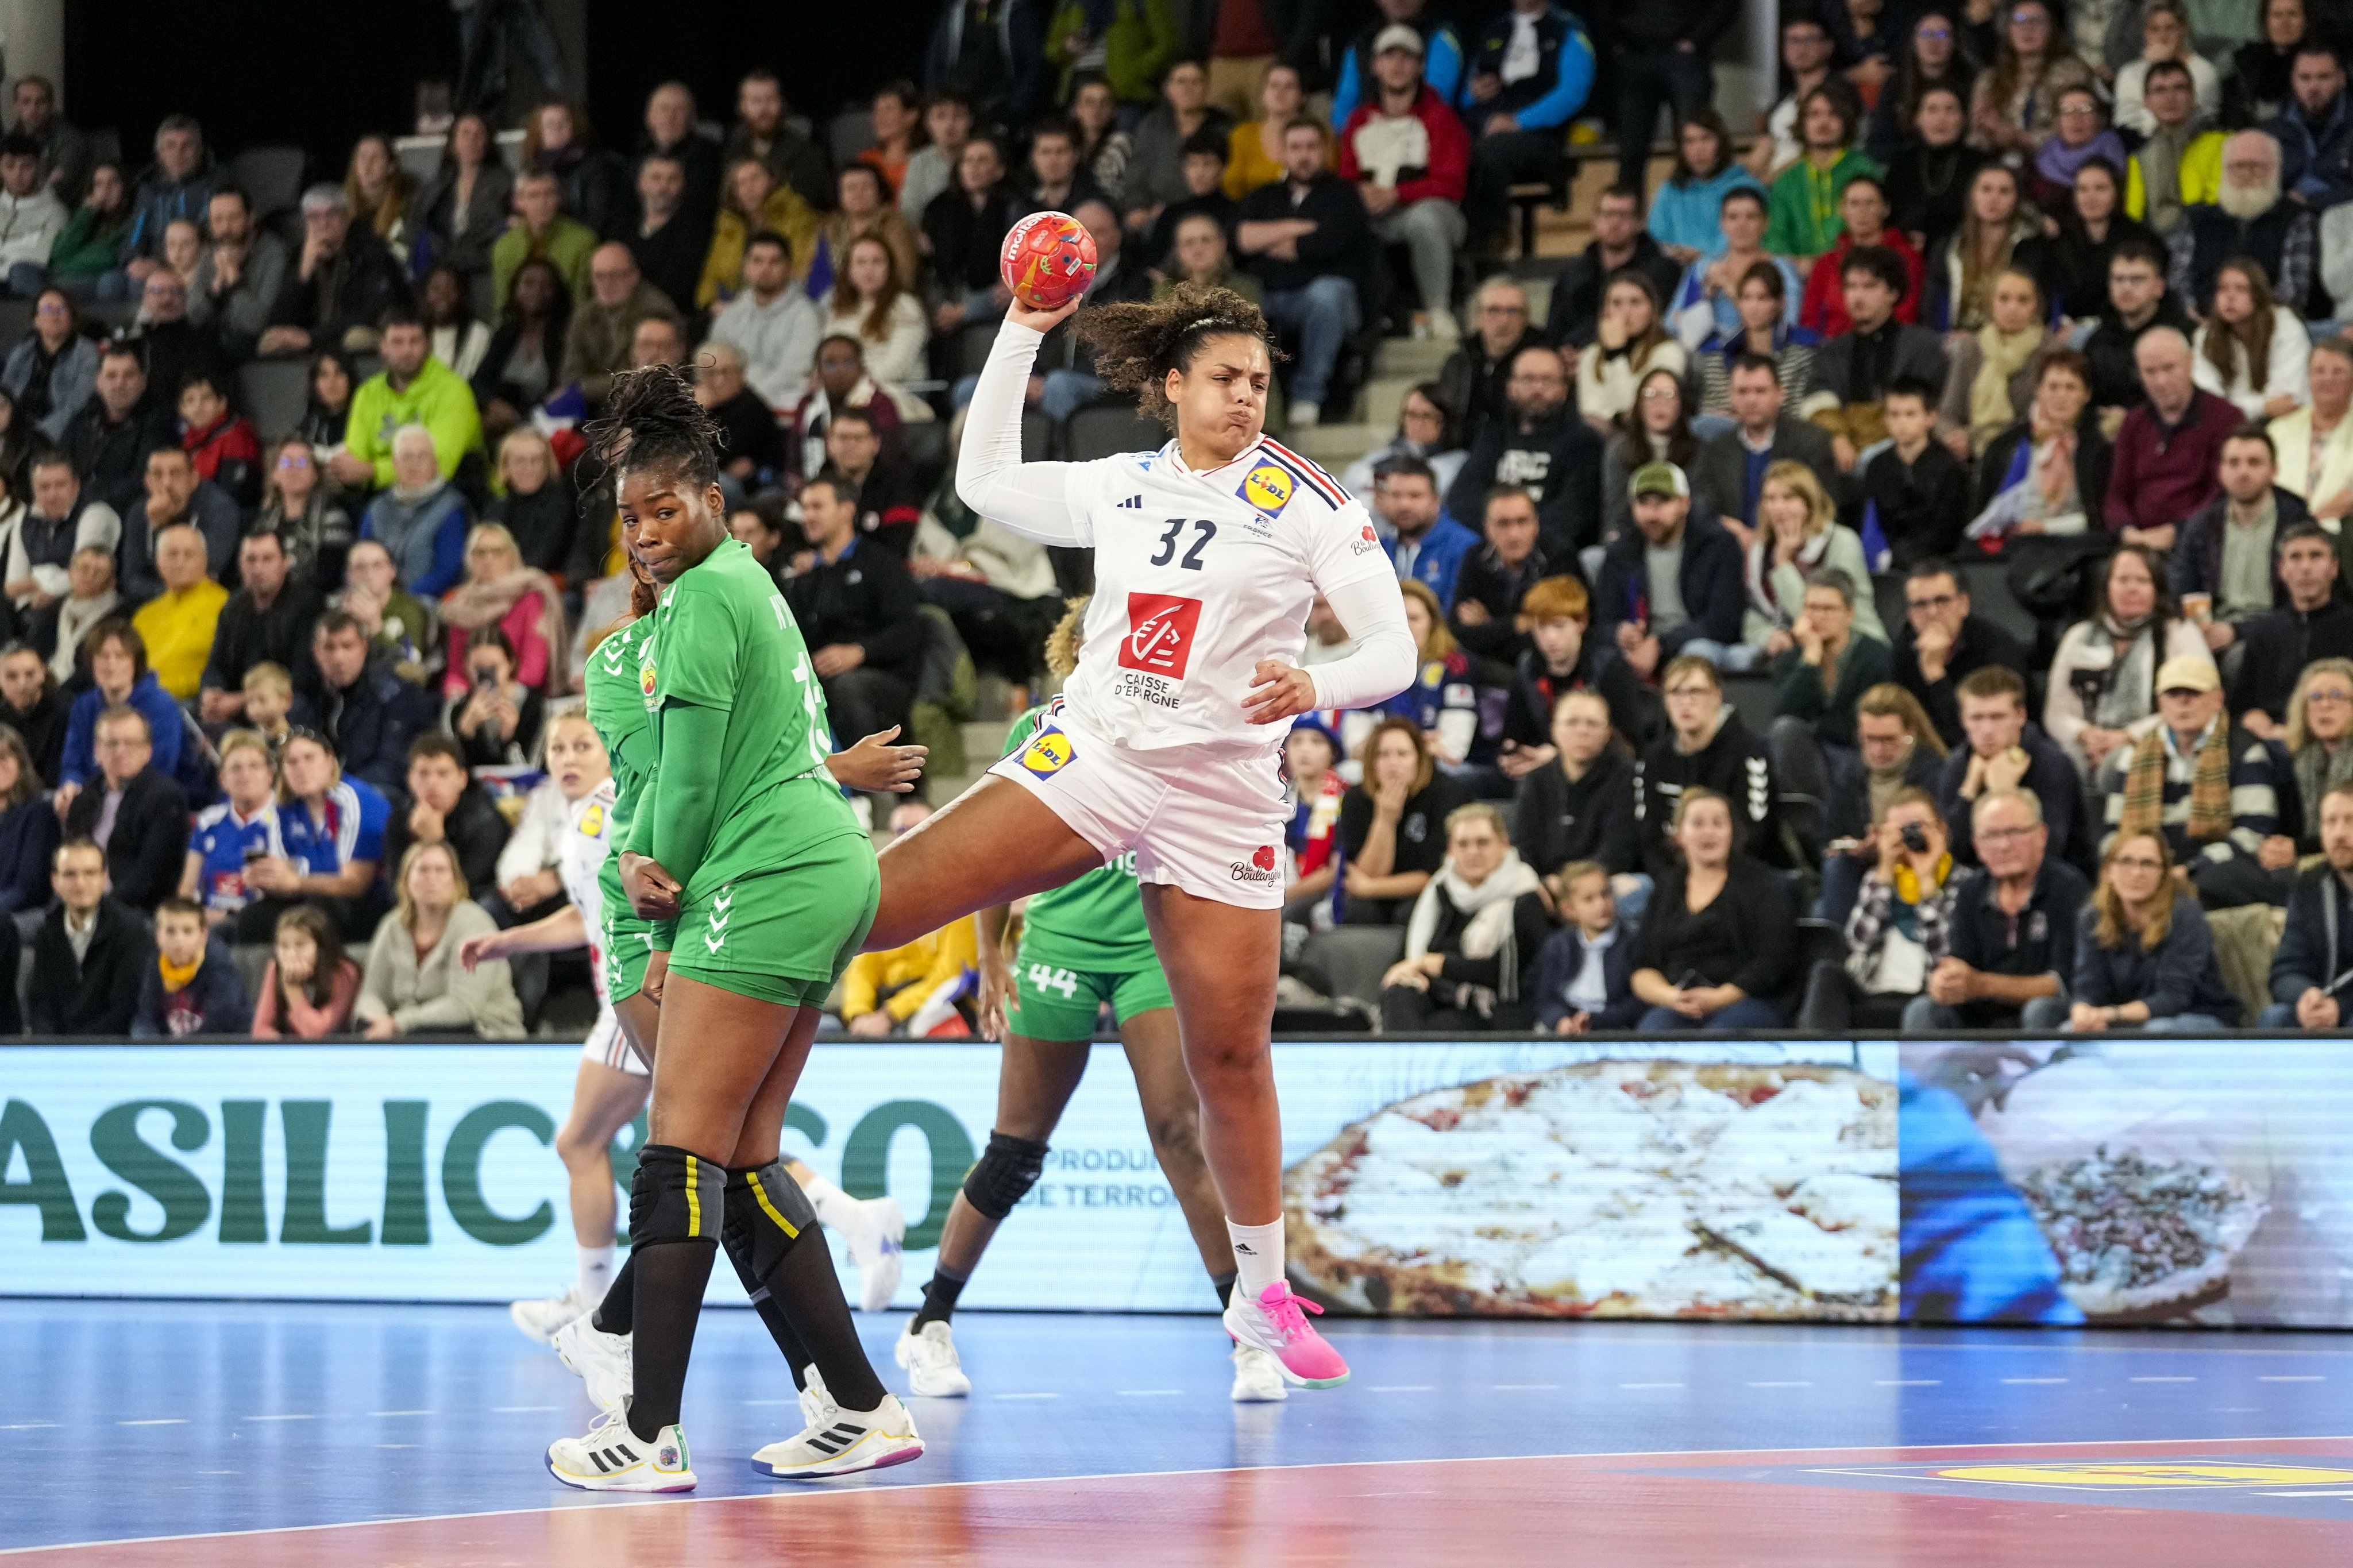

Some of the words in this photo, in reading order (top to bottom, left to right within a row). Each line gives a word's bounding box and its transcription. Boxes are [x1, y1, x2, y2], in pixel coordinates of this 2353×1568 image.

[1008, 213, 1050, 261] molten
[1150, 519, 1217, 571] 32
[1125, 674, 1170, 694] CAISSE
[1028, 963, 1078, 999] 44
